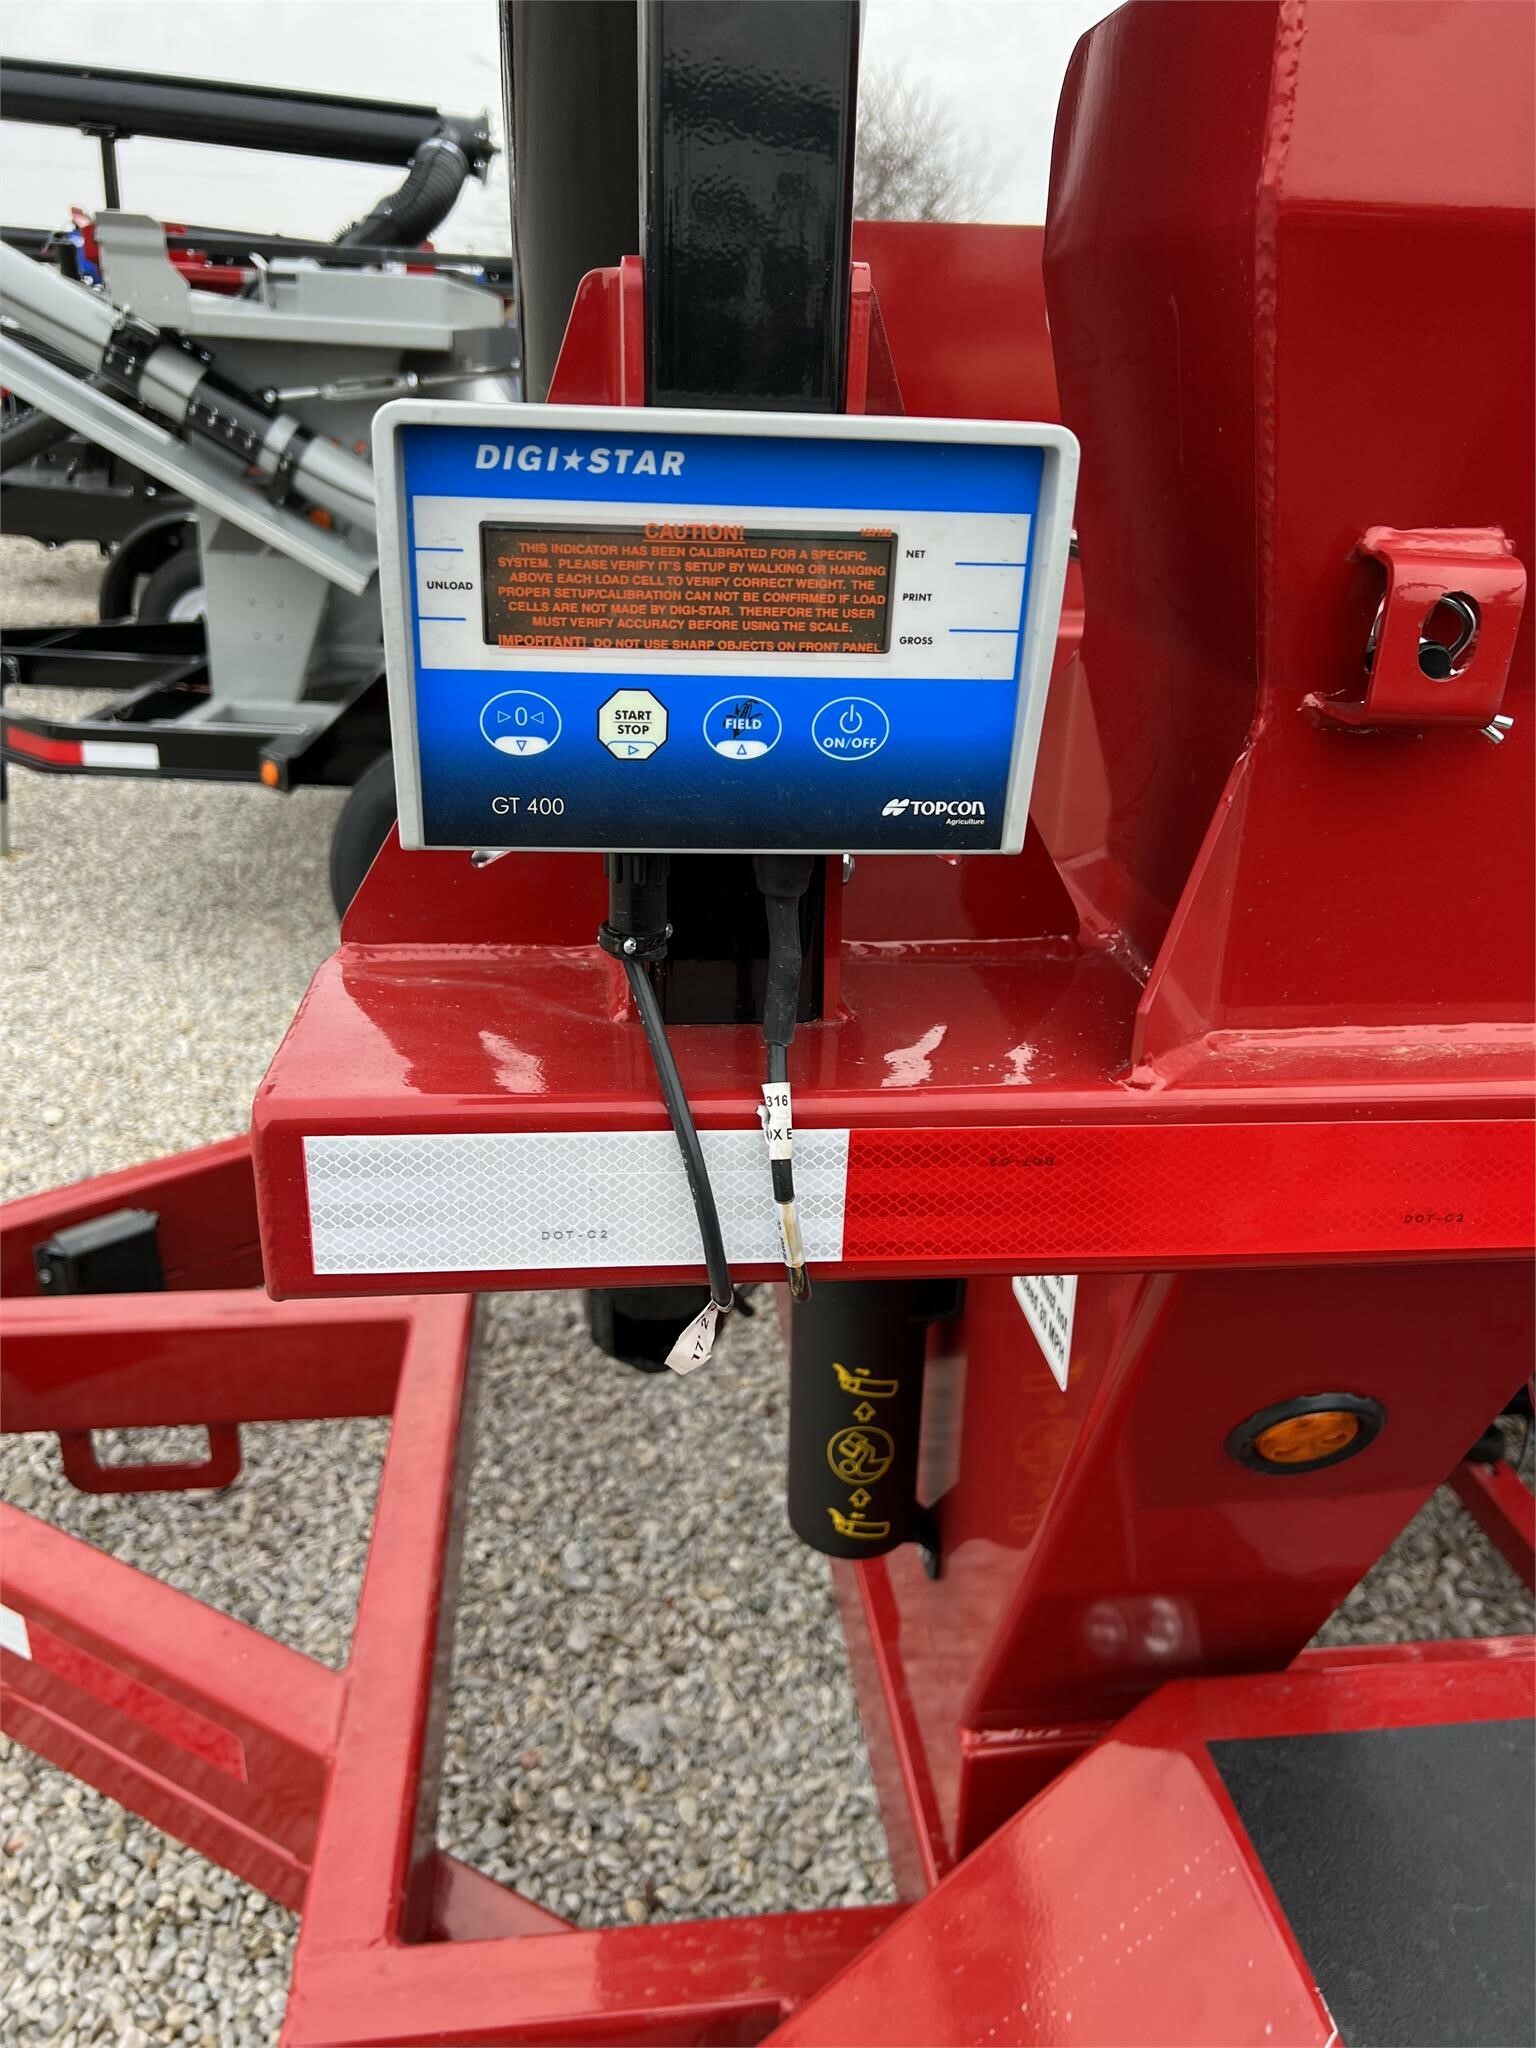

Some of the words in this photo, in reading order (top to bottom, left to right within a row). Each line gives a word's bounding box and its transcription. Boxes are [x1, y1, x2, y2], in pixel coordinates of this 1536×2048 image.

[645, 523, 744, 541] CAUTION!
[519, 543, 547, 553] THIS
[552, 544, 618, 555] INDICATOR
[622, 545, 647, 555] HAS
[651, 546, 685, 556] BEEN
[689, 548, 767, 558] CALIBRATED
[771, 549, 795, 559] FOR
[800, 550, 808, 559] A
[811, 550, 867, 561] SPECIFIC
[906, 550, 926, 559] NET
[498, 557, 551, 568] SYSTEM.
[558, 559, 607, 570] PLEASE
[611, 560, 653, 571] VERIFY
[659, 561, 680, 571] IT'S
[685, 563, 725, 572] SETUP
[729, 564, 744, 573] BY
[748, 564, 804, 574] WALKING
[808, 565, 826, 574] OR
[830, 565, 886, 576] HANGING
[427, 580, 473, 591] UNLOAD
[510, 573, 552, 583] ABOVE
[557, 574, 591, 584] EACH
[595, 575, 628, 585] LOAD
[632, 576, 664, 585] CELL
[667, 576, 683, 586] TO
[687, 577, 729, 587] VERIFY
[733, 578, 793, 588] CORRECT
[796, 579, 845, 589] WEIGHT.
[852, 580, 875, 590] THE
[499, 587, 549, 597] PROPER
[554, 588, 681, 600] SETUP/CALIBRATION
[685, 591, 710, 601] CAN
[714, 592, 739, 601] NOT
[743, 593, 759, 602] BE
[763, 593, 835, 603] CONFIRMED
[840, 594, 849, 603] IF
[853, 595, 885, 604] LOAD
[902, 593, 932, 602] PRINT
[509, 602, 549, 612] CELLS
[552, 603, 578, 613] ARE
[582, 604, 606, 613] NOT
[611, 604, 646, 614] MADE
[650, 605, 666, 615] BY
[670, 605, 733, 616] DIGI-STAR.
[739, 607, 813, 617] THEREFORE
[816, 608, 838, 618] THE
[843, 608, 875, 619] USER
[532, 617, 566, 627] MUST
[570, 617, 613, 628] VERIFY
[617, 619, 684, 629] ACCURACY
[688, 620, 738, 630] BEFORE
[742, 621, 779, 631] USING
[783, 622, 805, 631] THE
[809, 622, 853, 632] SCALE.
[499, 634, 586, 647] IMPORTANT!
[594, 638, 611, 648] DO
[616, 639, 640, 649] NOT
[644, 639, 669, 649] USE
[673, 640, 714, 650] SHARP
[717, 640, 773, 651] OBJECTS
[778, 641, 794, 651] ON
[799, 641, 838, 652] FRONT
[842, 642, 883, 652] PANEL.
[899, 636, 933, 645] GROSS
[514, 706, 528, 726] 0
[615, 710, 652, 721] START
[617, 724, 649, 735] STOP
[725, 718, 762, 730] FIELD
[823, 737, 877, 749] ON/OFF
[492, 797, 520, 815] GT
[527, 798, 565, 815] 400
[910, 801, 986, 816] TOPCON
[946, 818, 985, 826] Agriculture
[766, 1095, 788, 1107] 316
[1404, 1213, 1464, 1223] DOT-C2
[541, 1229, 608, 1240] DOT-C2
